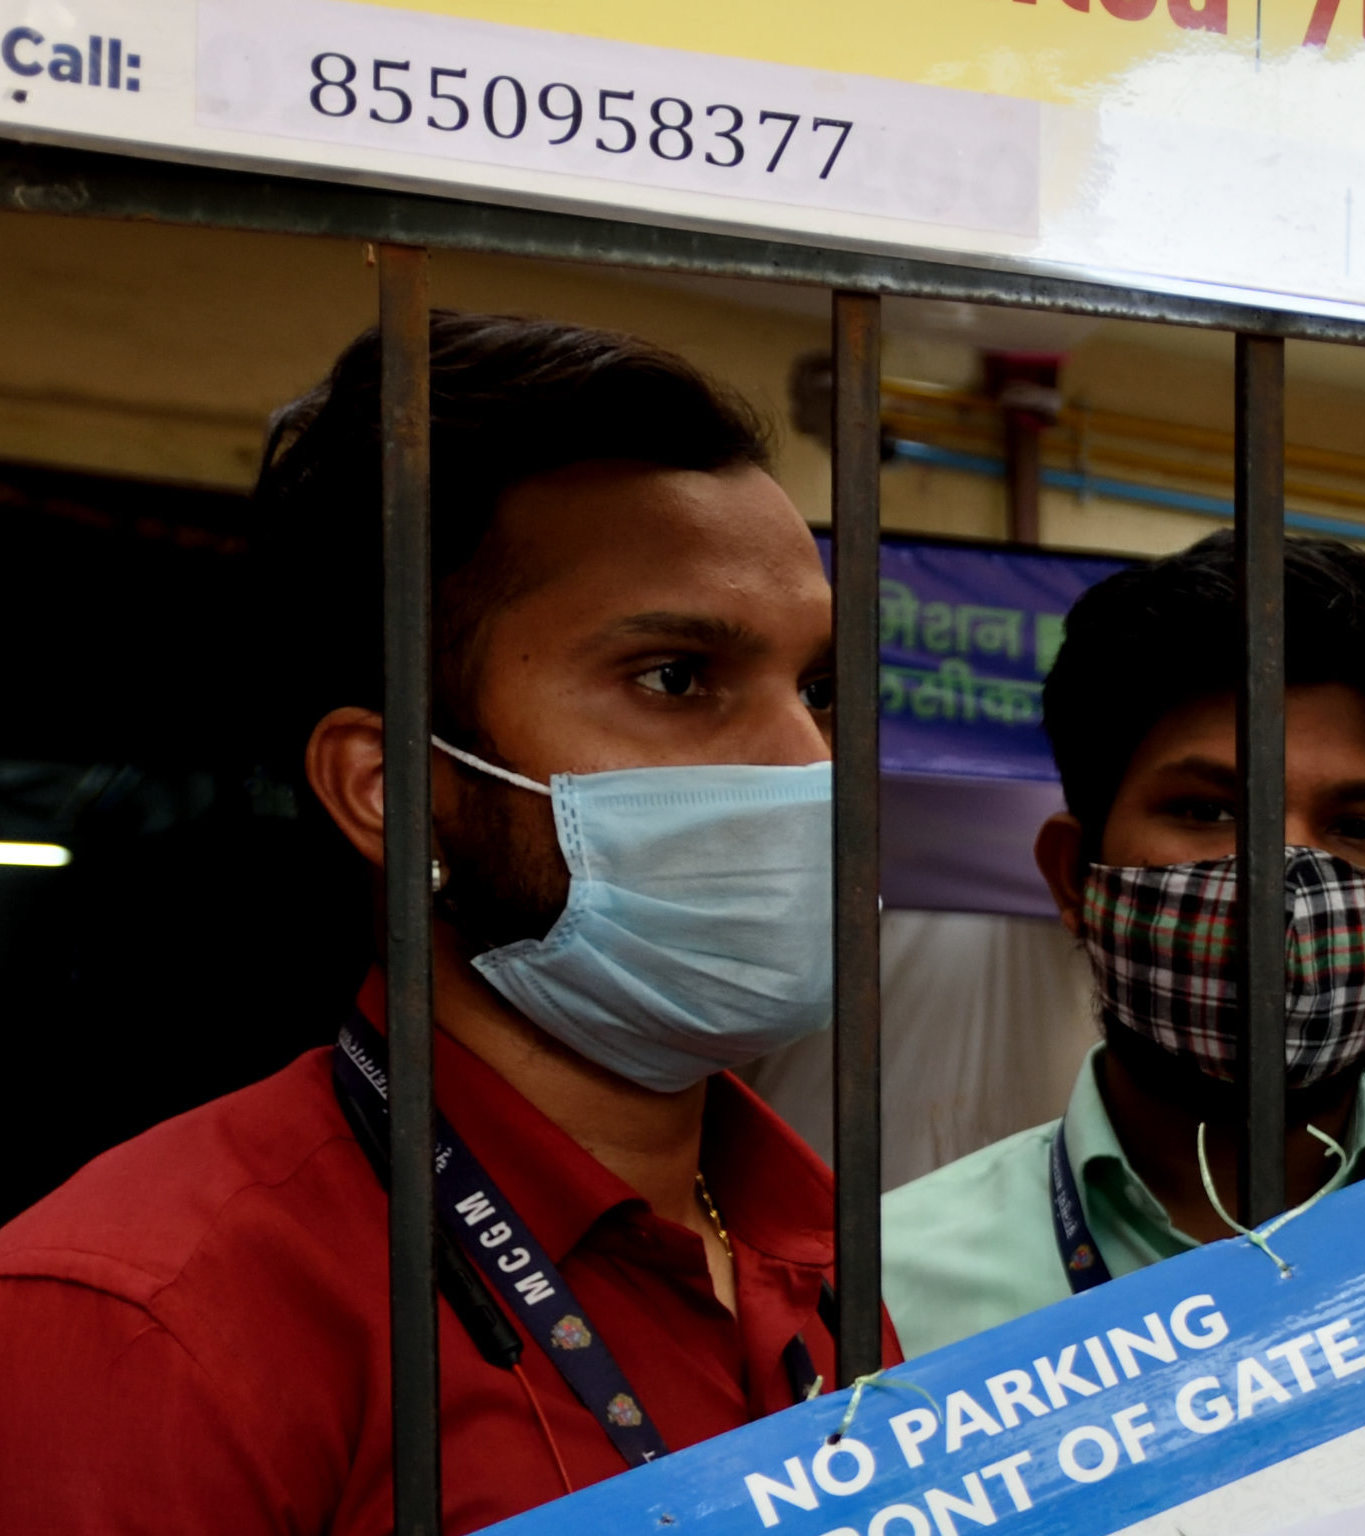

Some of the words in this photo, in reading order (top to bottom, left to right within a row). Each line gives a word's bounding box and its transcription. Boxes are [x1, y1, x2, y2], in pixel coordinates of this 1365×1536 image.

[1, 26, 141, 92] Call:
[309, 51, 854, 180] 8550958377
[744, 1438, 875, 1528] NO
[889, 1294, 1230, 1468] PARKING
[1057, 1402, 1157, 1484] OF
